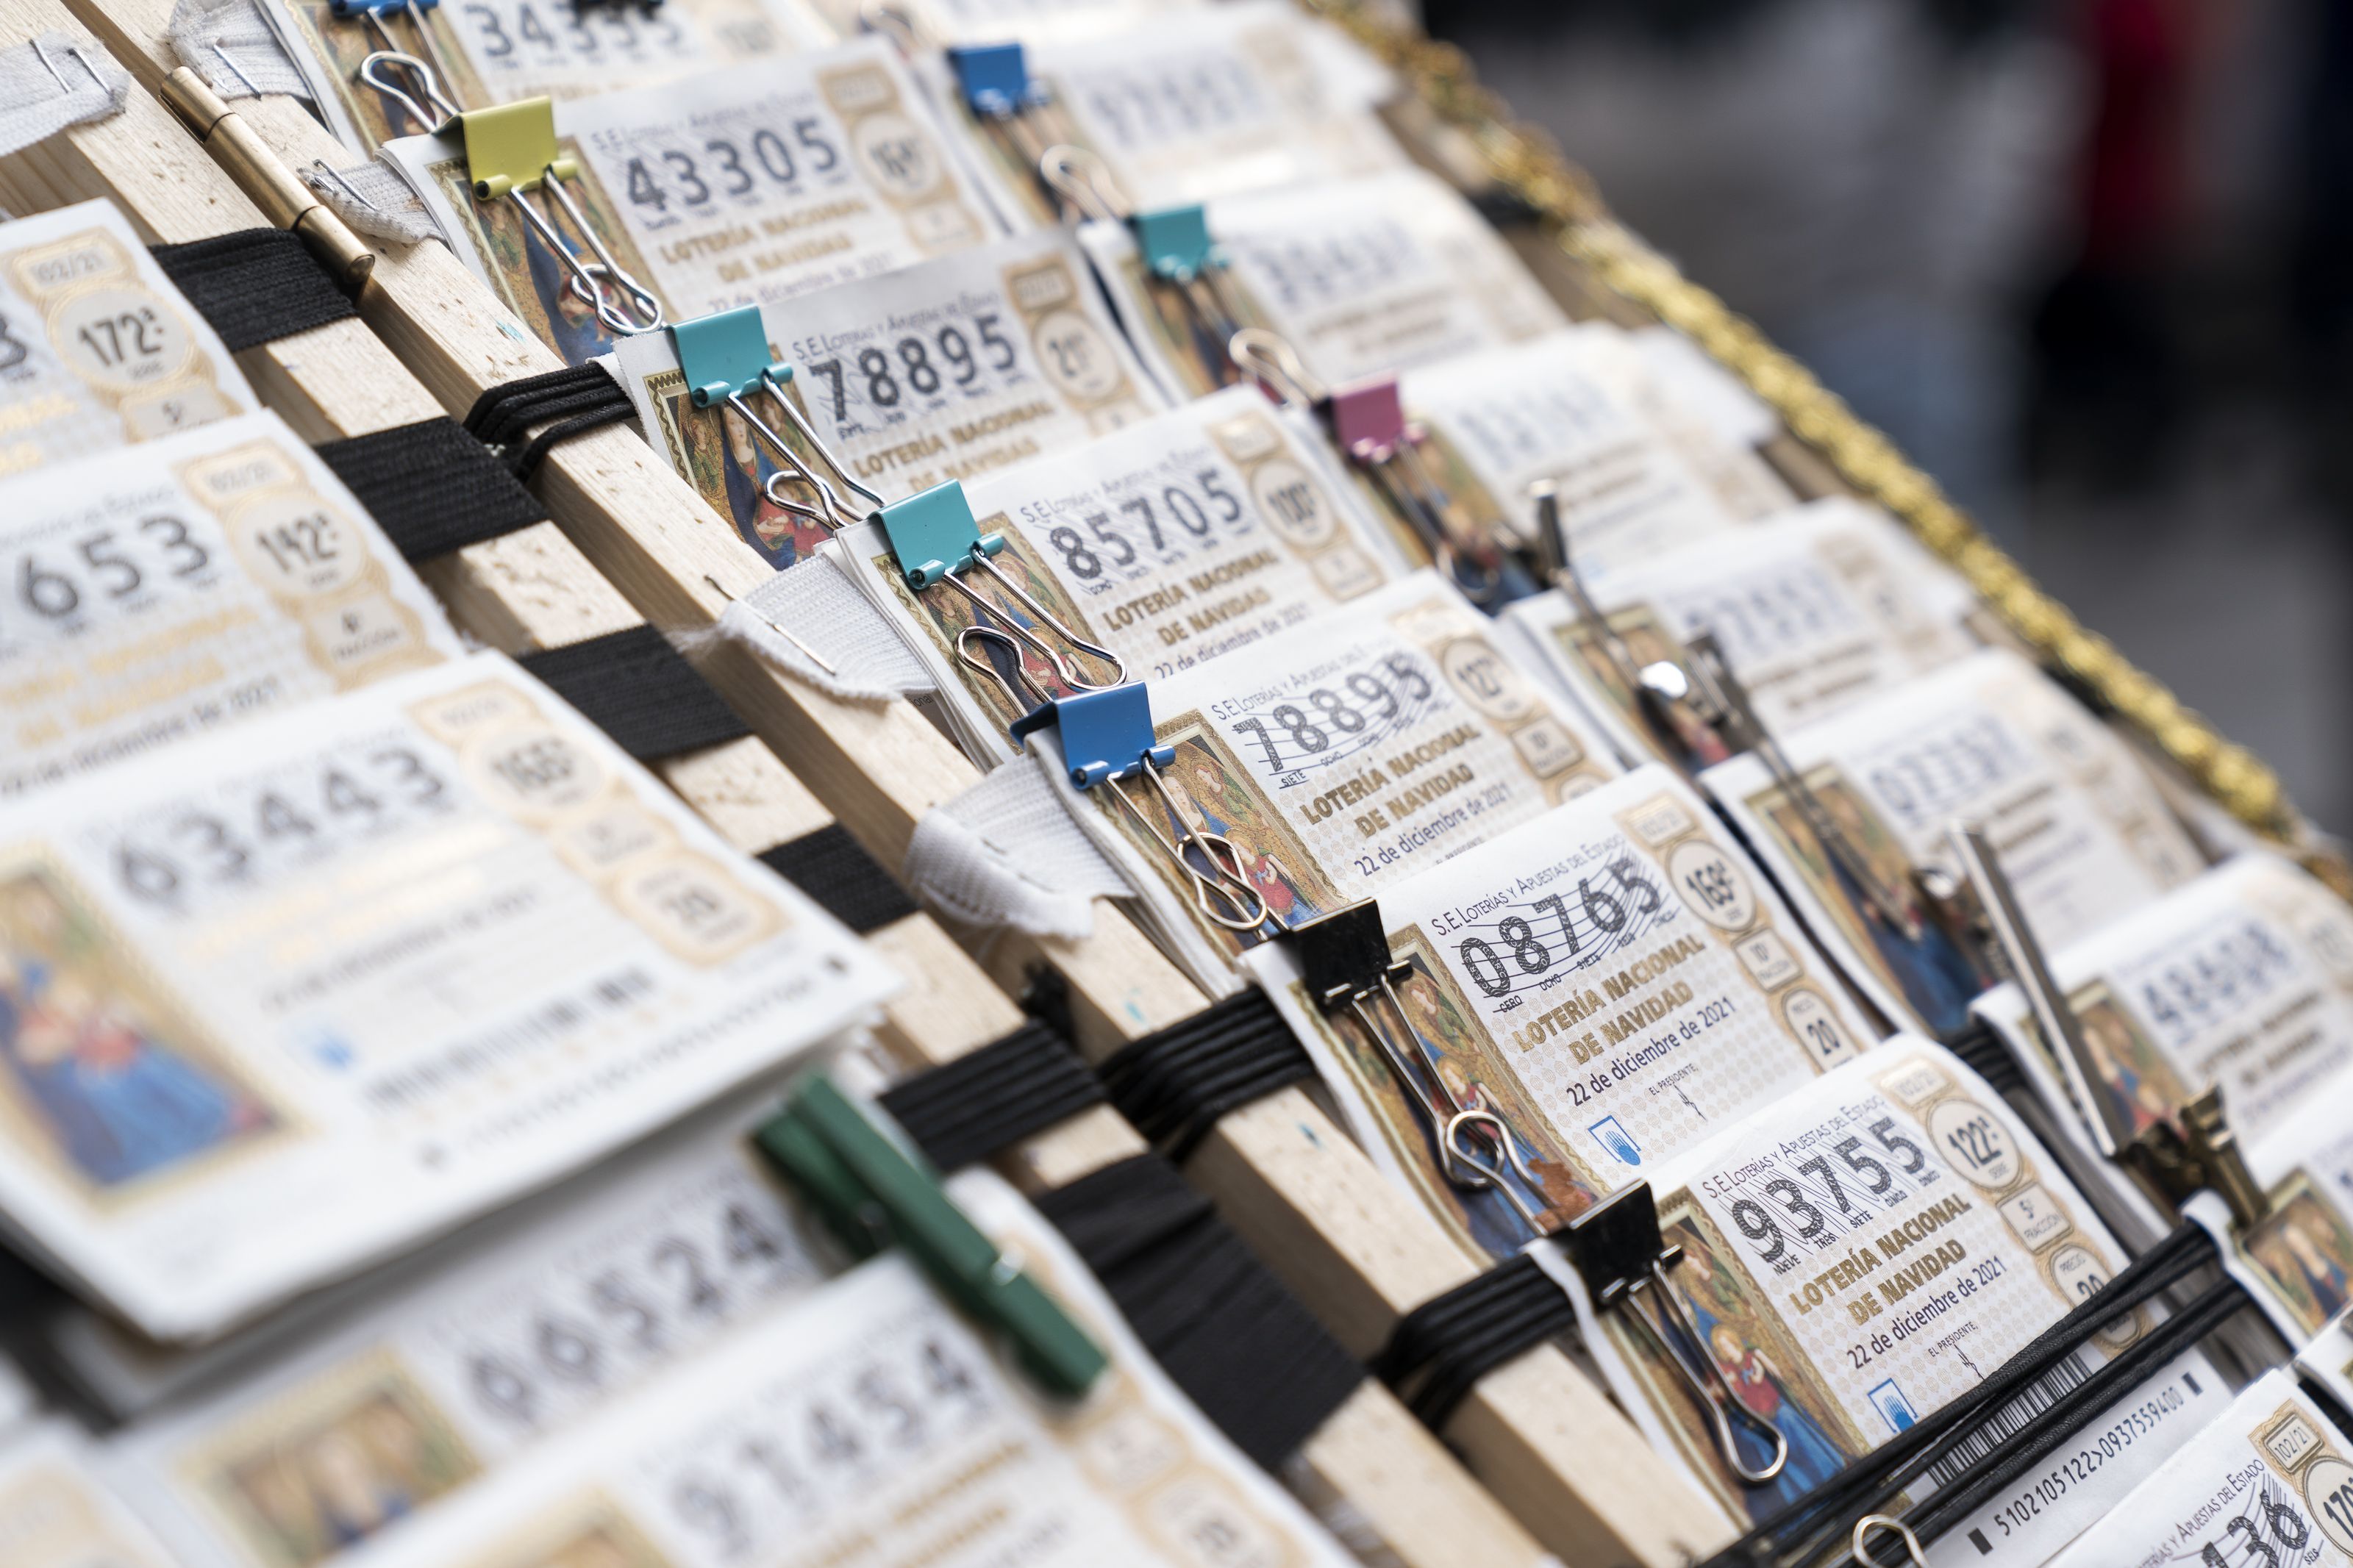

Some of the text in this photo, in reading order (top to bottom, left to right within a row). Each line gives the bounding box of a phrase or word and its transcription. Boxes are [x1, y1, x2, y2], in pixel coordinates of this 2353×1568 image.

[628, 118, 836, 212] 43305
[808, 314, 1015, 422] 78895
[853, 432, 947, 478] LOTERÍA
[1050, 468, 1241, 579] 85705
[1102, 581, 1190, 632] LOTERÍA
[1187, 549, 1280, 593] NACIONAL
[1157, 586, 1272, 647] DE NAVIDAD
[1197, 629, 1262, 662] diciembre
[1211, 701, 1240, 721] S.E.
[1232, 684, 1282, 712] LOTERÍAS
[1232, 651, 1431, 772] 78895
[1281, 769, 1306, 788] SIETE
[1299, 767, 1391, 826] LOTERÍA
[1386, 724, 1482, 778] NACIONAL
[1354, 762, 1474, 839] DE NAVIDAD
[110, 744, 445, 904] 63443
[1354, 781, 1515, 877] 22 de diciembre de 2021
[1432, 912, 1463, 936] S.E.
[1455, 892, 1509, 925] LOTERÍAS
[1507, 888, 1518, 899] Y
[1515, 862, 1568, 895] APUESTAS
[1566, 853, 1588, 870] DEL
[1460, 857, 1660, 998] 08765
[1499, 995, 1523, 1013] CERO
[1539, 973, 1562, 991] OCHO
[1512, 934, 1706, 1053] LOTERÍA NACIONAL
[1568, 981, 1694, 1065] DE NAVIDAD
[1566, 995, 1736, 1106] 22 de diciembre de 2021
[1649, 1063, 1699, 1096] EL PRESIDENTE,
[1806, 1018, 1840, 1056] 20
[1702, 1095, 1885, 1199] S.E. LOTERÍAS Y APUESTAS DEL ESTADO
[1732, 1116, 1925, 1263] 93755
[1773, 1253, 1802, 1277] NUEVE
[1814, 1232, 1837, 1250] TRES
[1849, 1210, 1874, 1229] SIETE
[1788, 1193, 1973, 1315] LOTERÍA NACIONAL
[1846, 1239, 1967, 1325] DE NAVIDAD
[1846, 1256, 2008, 1370] 22 de diciembre de 2021
[1928, 1321, 1979, 1358] EL PRESIDENTE,
[2274, 1427, 2310, 1461] 102/21
[2169, 1459, 2265, 1549] Y APUESTAS DEL ESTADO
[2304, 1547, 2320, 1567] SEIS
